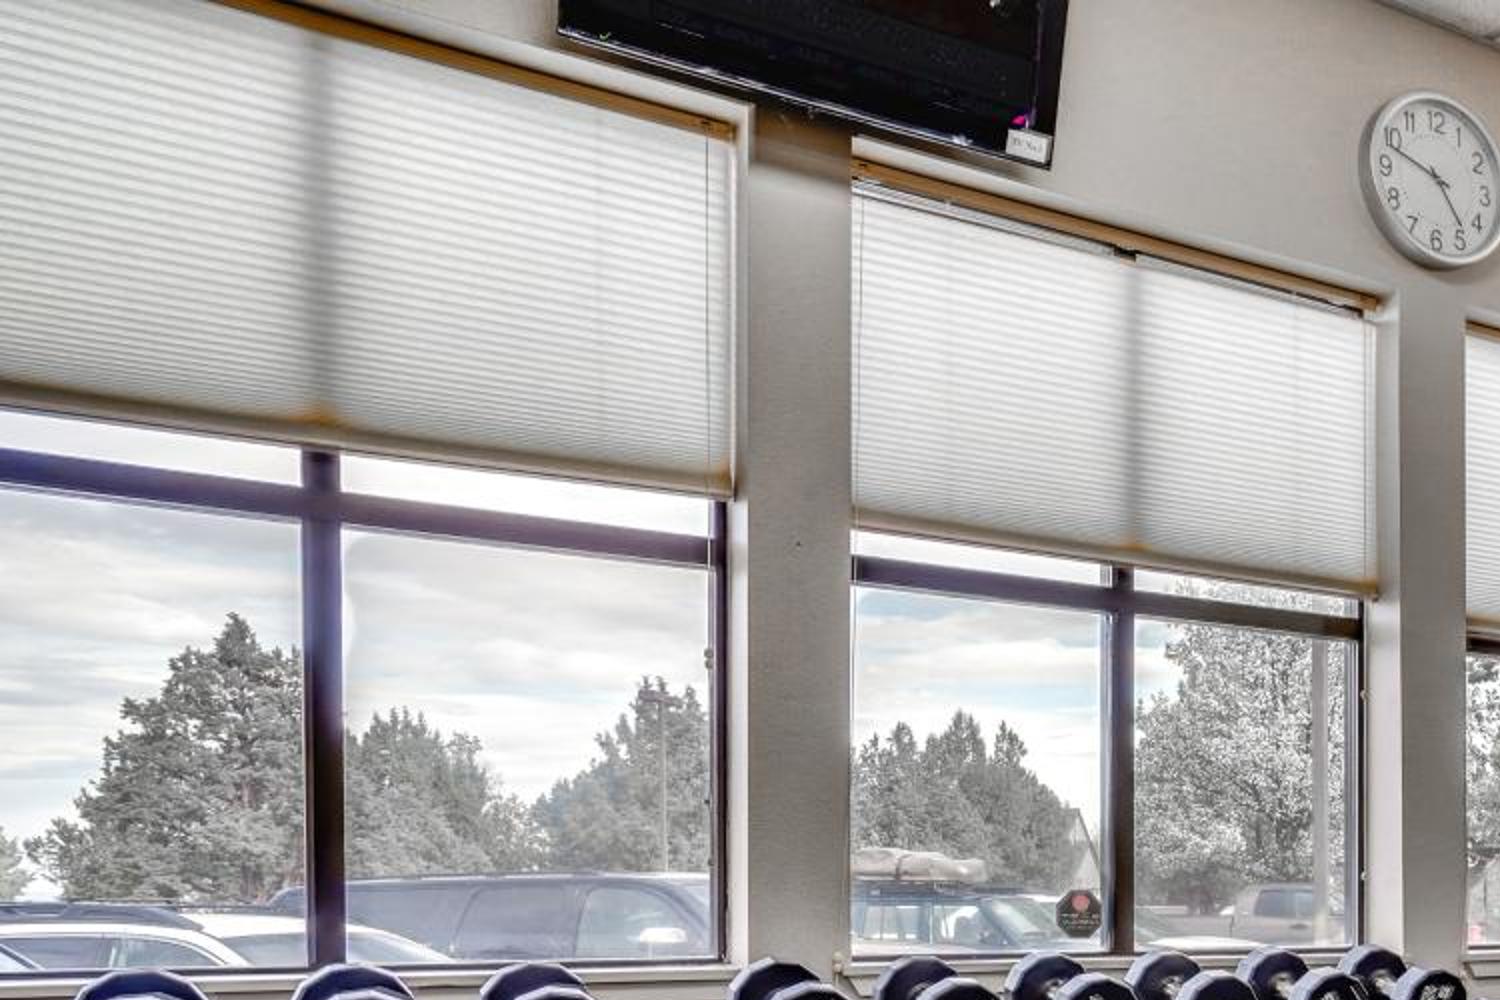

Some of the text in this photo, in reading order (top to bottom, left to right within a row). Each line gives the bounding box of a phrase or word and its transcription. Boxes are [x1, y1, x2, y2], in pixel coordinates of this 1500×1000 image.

[1403, 110, 1416, 134] 11
[1427, 110, 1446, 135] 12
[1384, 125, 1402, 149] 10
[1456, 126, 1462, 149] 1
[1379, 153, 1393, 177] 9
[1471, 151, 1484, 175] 2
[1387, 186, 1401, 211] 8
[1479, 185, 1491, 207] 3
[1407, 215, 1419, 234] 7
[1471, 212, 1483, 233] 4
[1430, 228, 1443, 251] 6
[1454, 228, 1467, 251] 5
